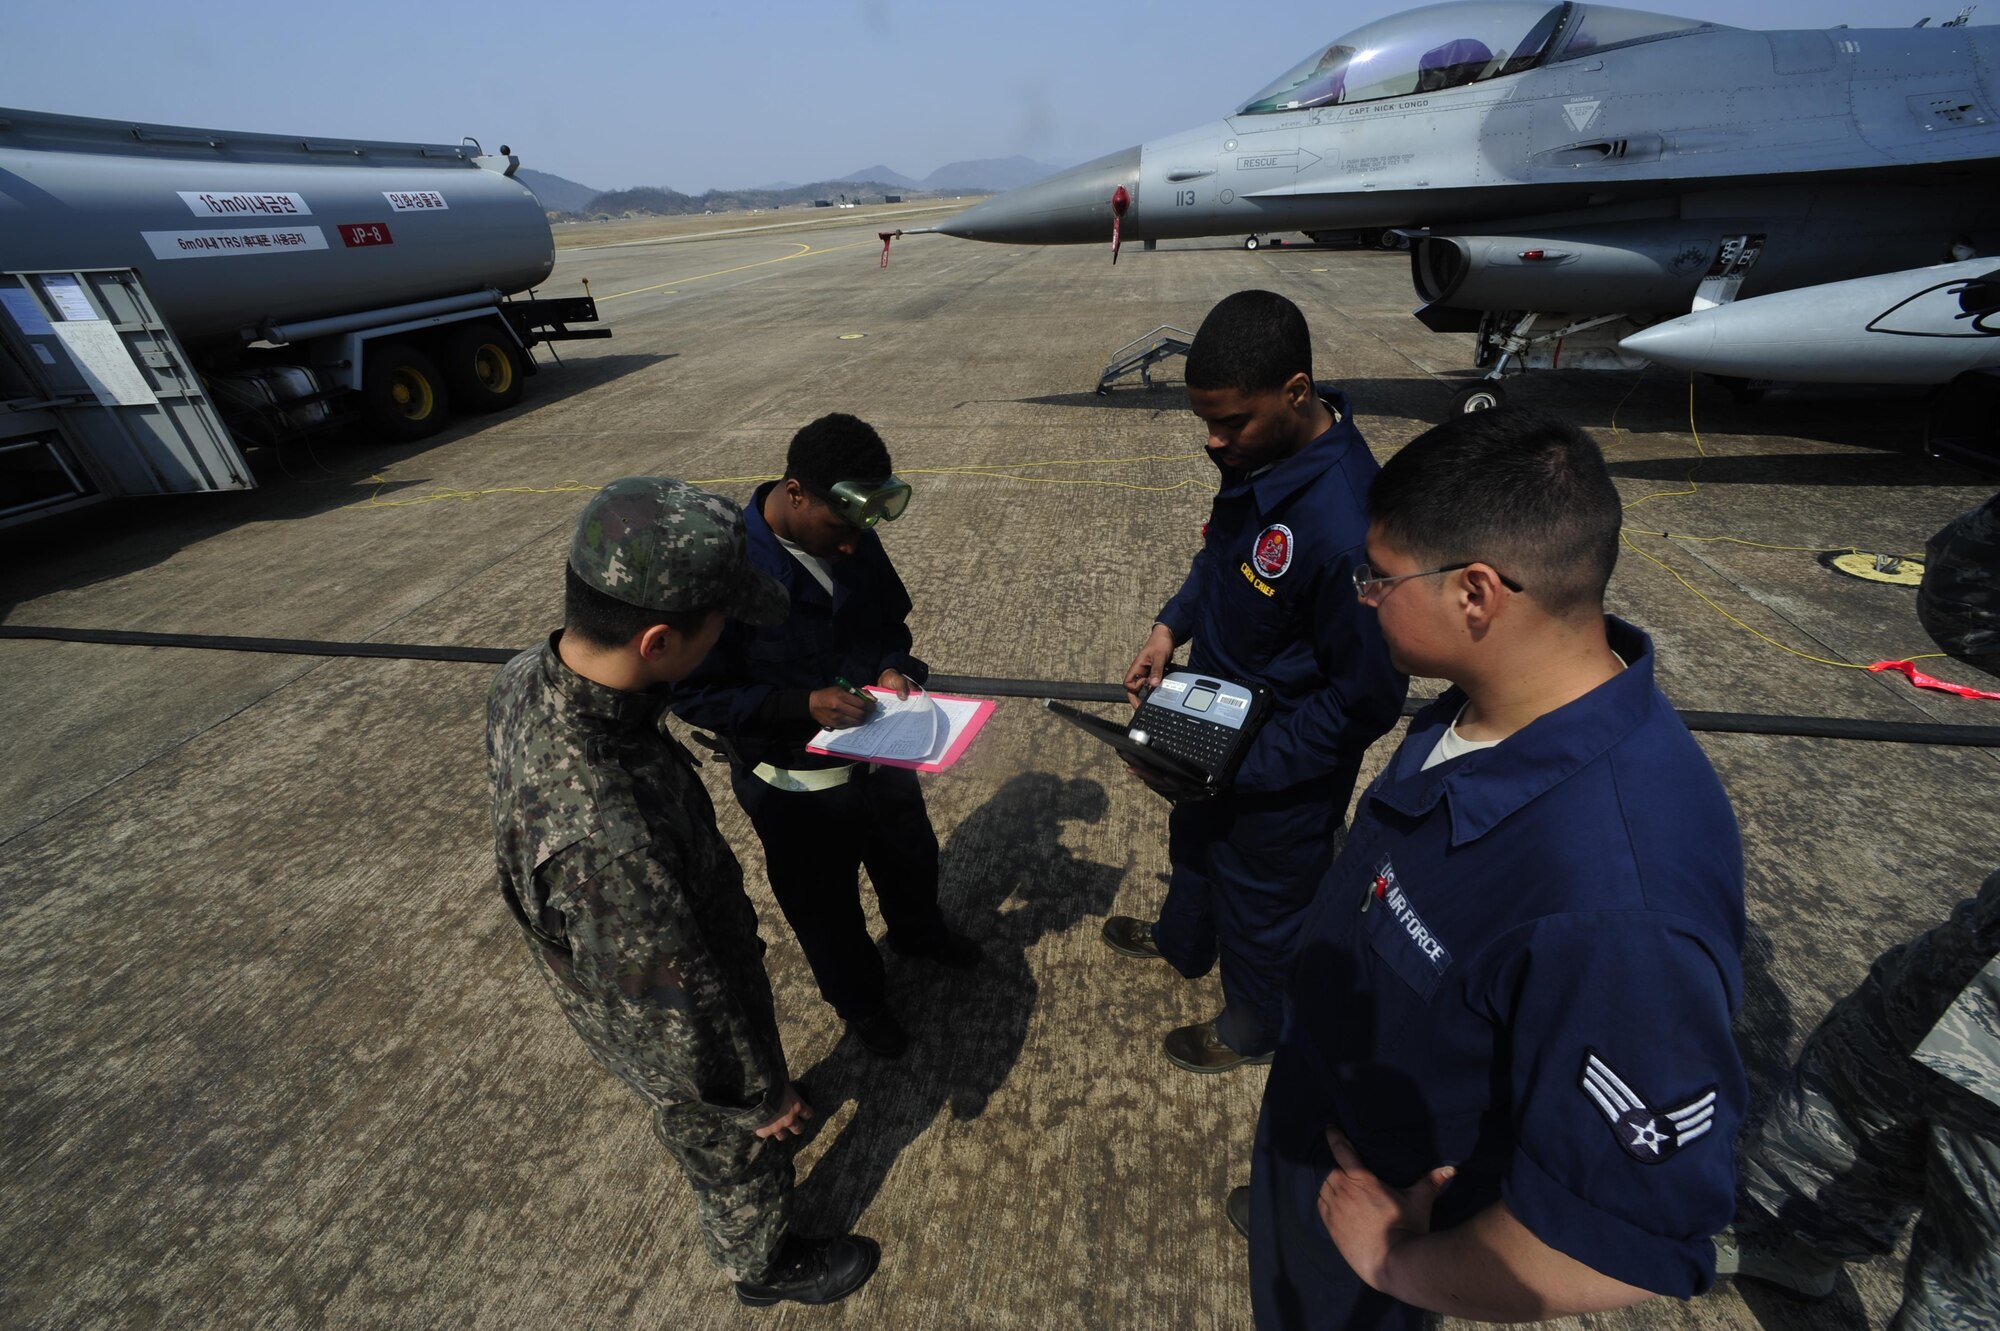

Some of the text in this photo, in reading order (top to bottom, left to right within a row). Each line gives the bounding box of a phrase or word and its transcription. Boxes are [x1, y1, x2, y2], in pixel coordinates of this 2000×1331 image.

[1570, 95, 1594, 103] DANGER
[1348, 99, 1429, 116] CAPT NICK LONGO
[1243, 157, 1278, 168] RESCUE
[389, 193, 444, 209] 인화성물질
[1176, 190, 1196, 206] 113
[271, 232, 306, 246] 사용금지
[352, 226, 382, 244] JP-8
[1240, 562, 1276, 597] CREW CHIEF
[1386, 886, 1407, 917] AIR
[1399, 909, 1445, 963] FORCE
